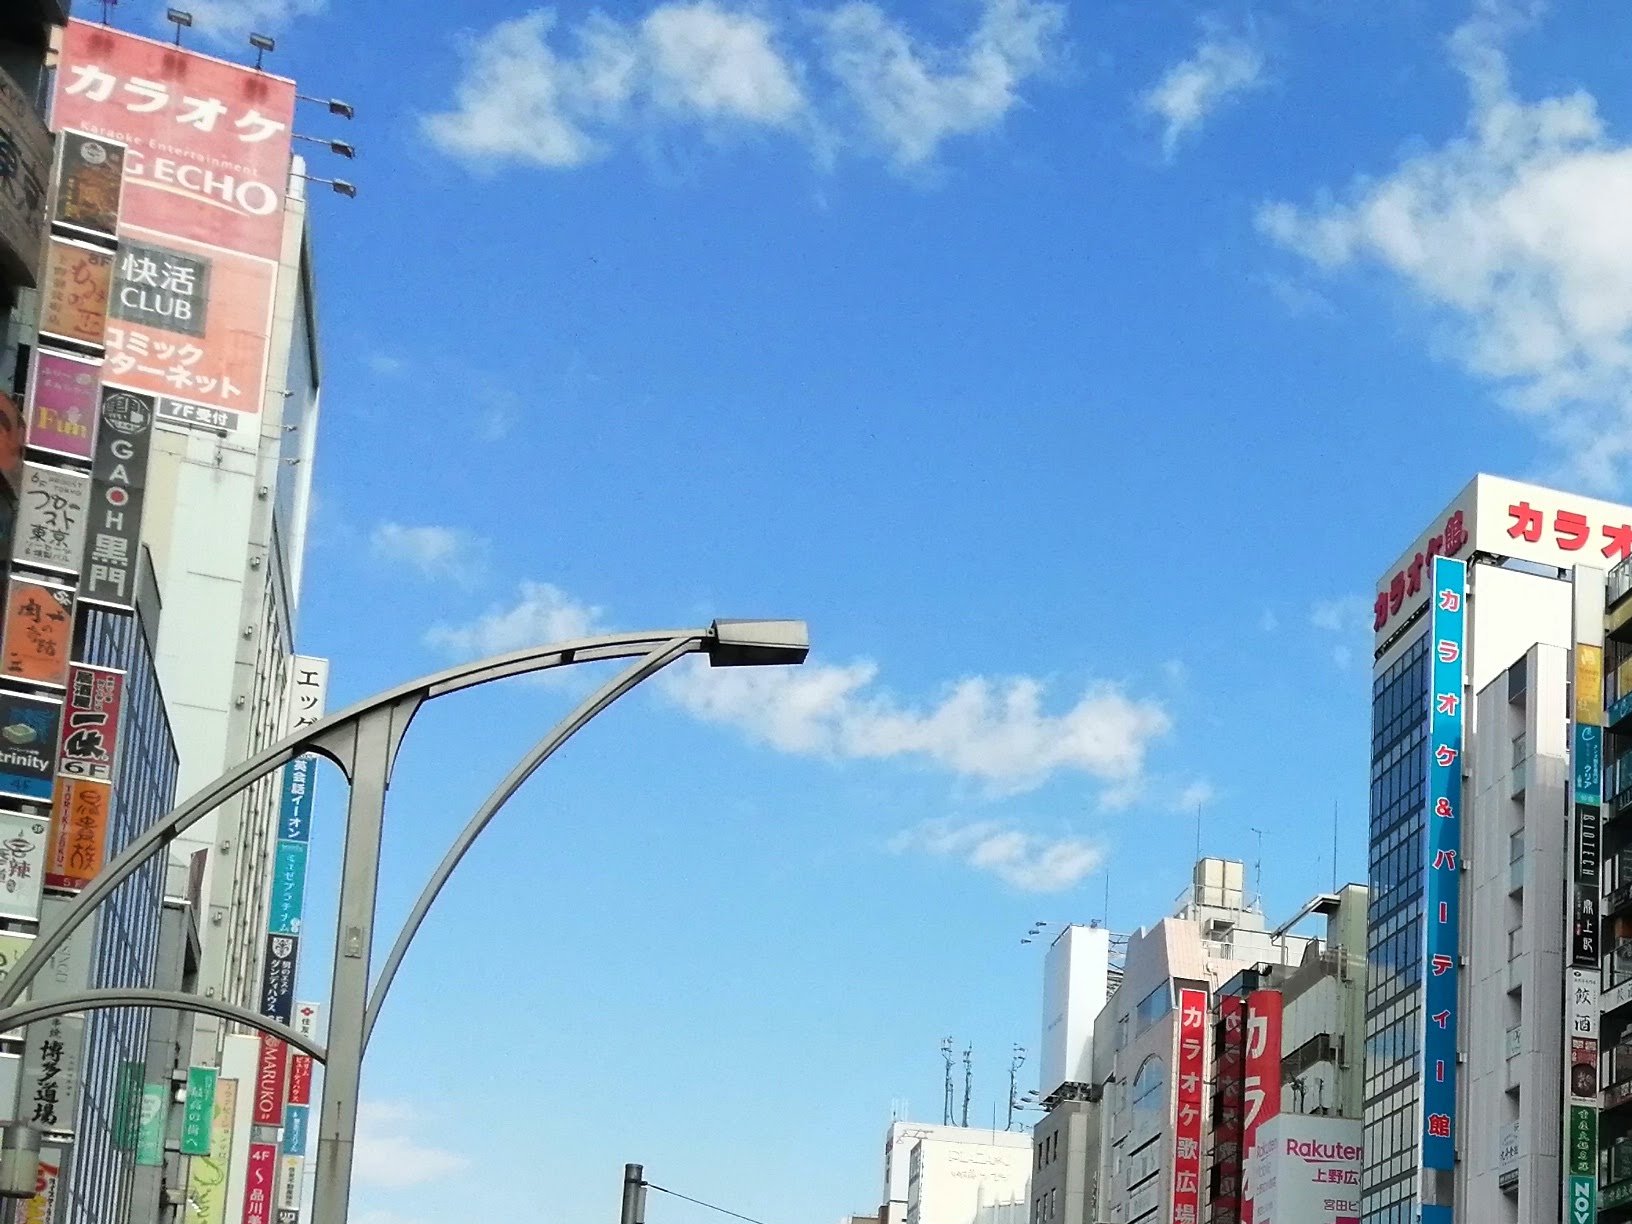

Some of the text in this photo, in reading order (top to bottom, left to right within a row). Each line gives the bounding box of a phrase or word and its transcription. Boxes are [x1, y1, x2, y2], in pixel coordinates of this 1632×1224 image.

[64, 63, 289, 143] カラオケ
[153, 159, 279, 216] ECHO
[121, 252, 195, 297] 快活
[119, 287, 192, 320] CLUB
[105, 327, 203, 361] コミック
[65, 761, 108, 776] 6F
[260, 1047, 277, 1112] MARUKO
[252, 1151, 270, 1160] 4F
[1312, 1168, 1361, 1186] 上野広
